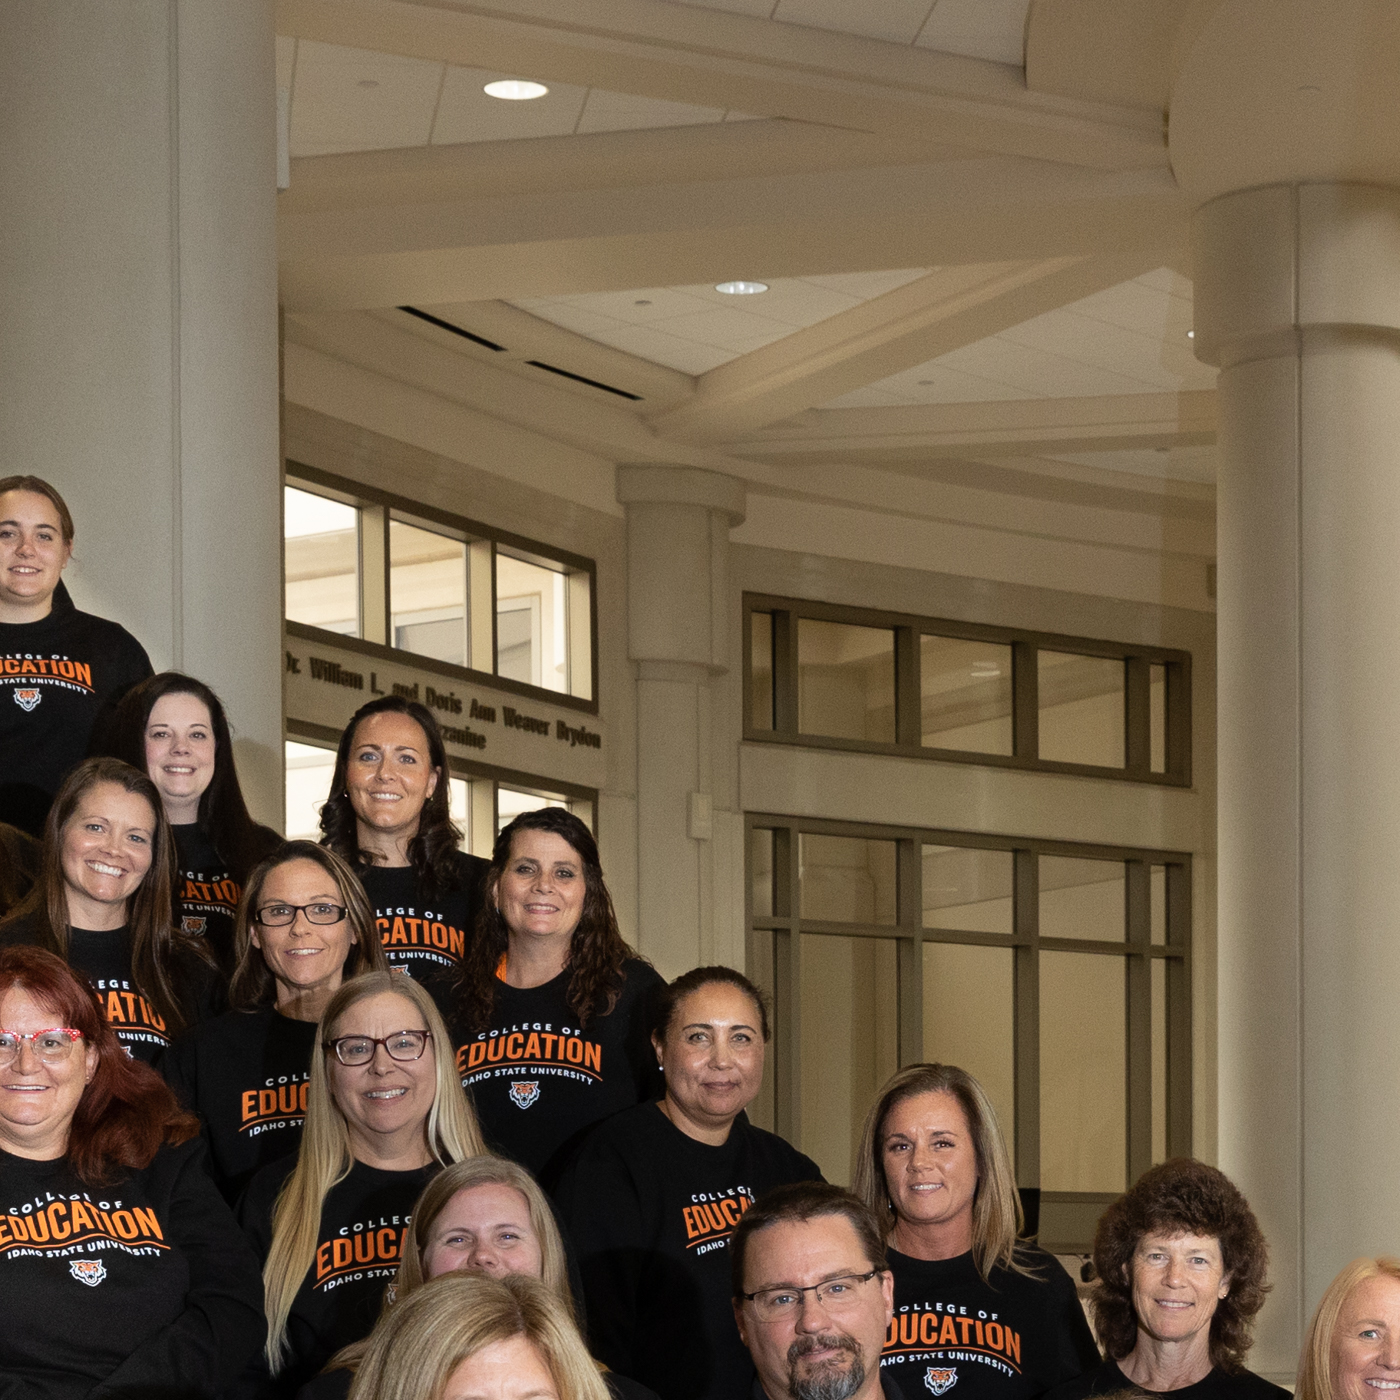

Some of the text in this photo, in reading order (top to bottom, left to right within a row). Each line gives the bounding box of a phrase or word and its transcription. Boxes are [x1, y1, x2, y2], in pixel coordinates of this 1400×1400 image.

[30, 677, 88, 695] UNIVERSITY
[309, 656, 364, 690] William
[469, 698, 496, 723] Ann
[502, 706, 550, 737] Weaver
[556, 720, 602, 749] Brydon
[376, 908, 443, 921] LEGE OF
[375, 917, 465, 958] CATION
[478, 1022, 581, 1040] COLLEGE OF
[456, 1032, 601, 1073] EDUCATION
[265, 1072, 310, 1087] COLL
[462, 1067, 593, 1088] DAHO STATE UNIVERSITY
[249, 1121, 286, 1137] IDAHO
[99, 1201, 123, 1210] OF
[7, 1248, 43, 1259] IDAHO
[46, 1245, 84, 1258] STATE
[697, 1240, 725, 1255] IDAHO
[324, 1268, 397, 1292] IDAHO STAT
[892, 1302, 998, 1321] OLLEGE OF
[883, 1313, 1021, 1365] DUCATION
[880, 1351, 1013, 1377] AHO STATE UNIVERSITY
